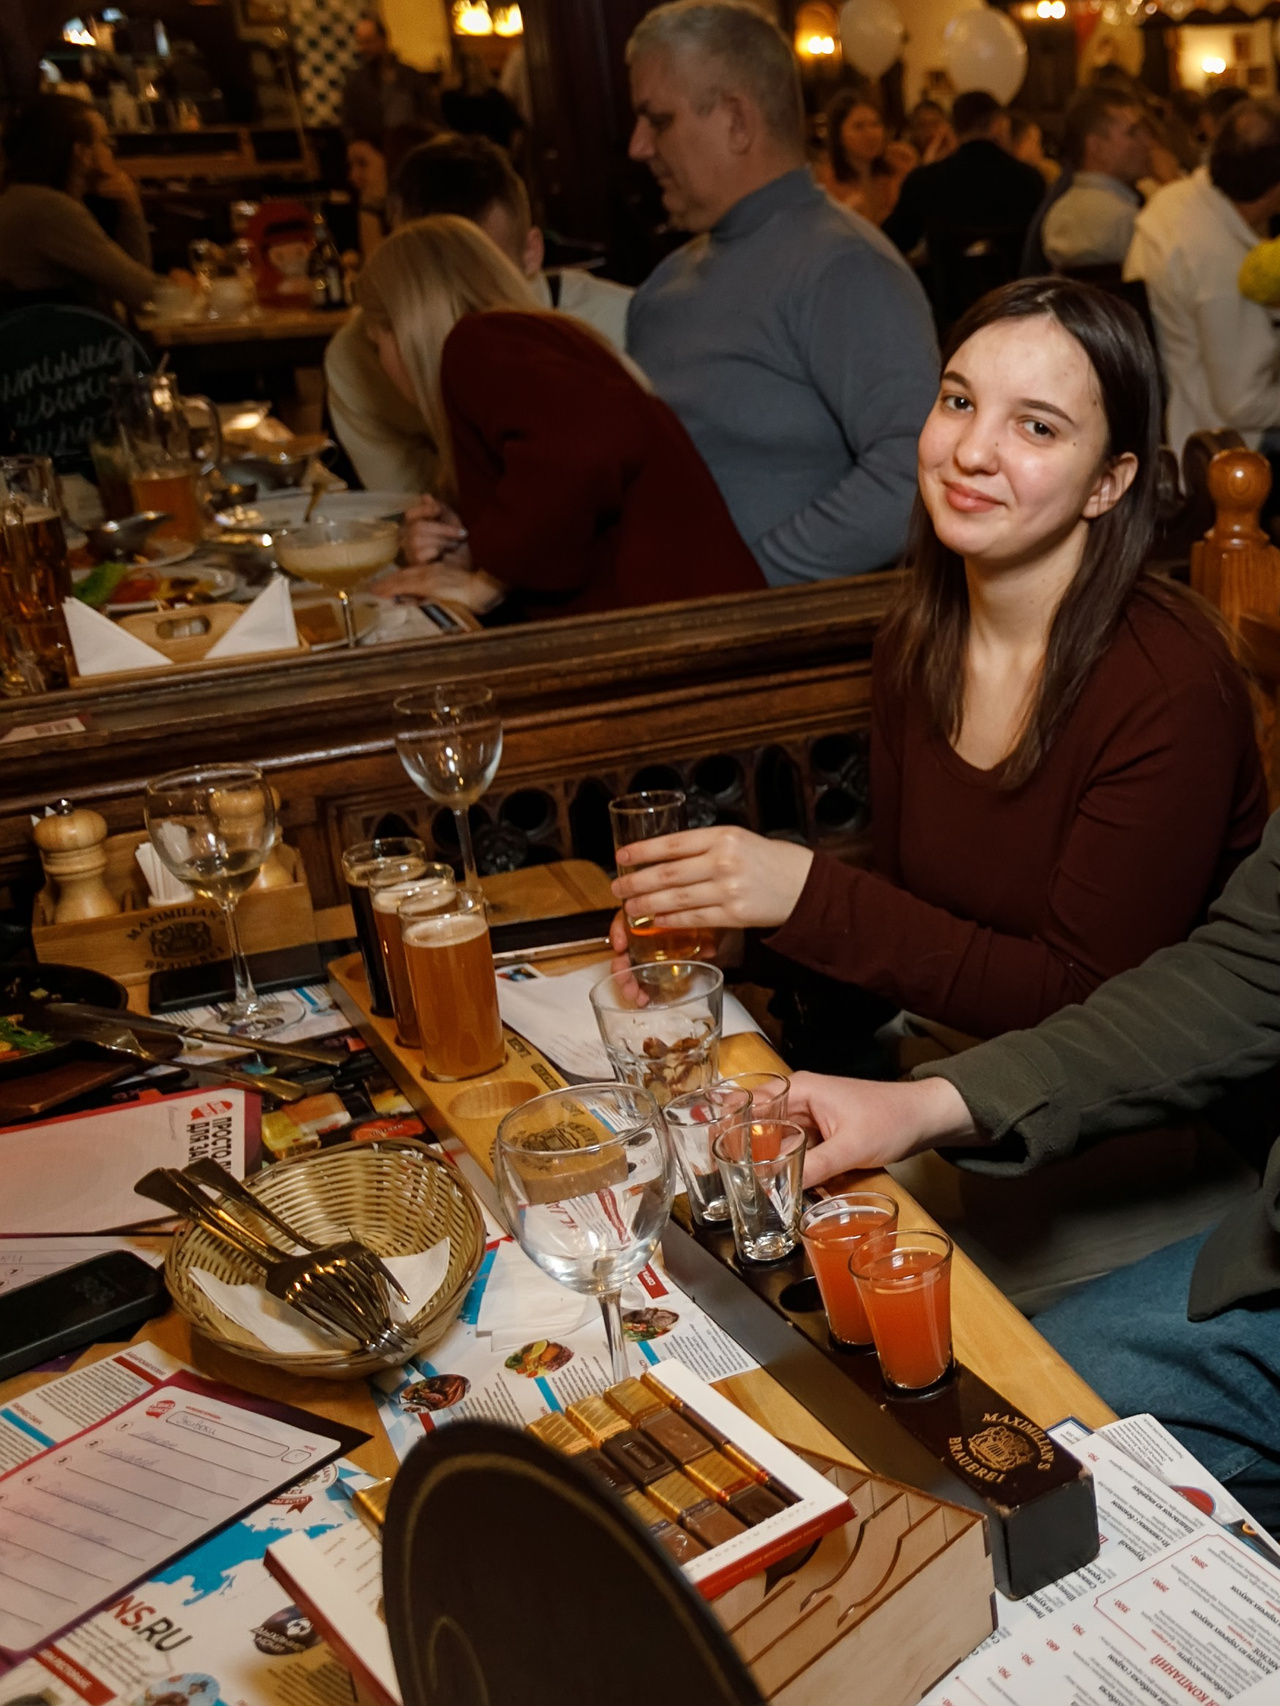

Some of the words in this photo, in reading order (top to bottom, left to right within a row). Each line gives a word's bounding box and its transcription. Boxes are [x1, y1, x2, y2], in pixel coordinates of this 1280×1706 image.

[186, 1121, 210, 1145] ДЛЯ
[211, 1116, 232, 1159] ПРОСТО
[982, 1412, 1055, 1471] MAXIMILIAN'S
[948, 1436, 1006, 1484] BRAUEREI
[1132, 1485, 1156, 1504] индейки
[1111, 1500, 1135, 1519] беконом
[1137, 1521, 1163, 1540] свинины
[1162, 1508, 1194, 1534] Шашлычок
[1118, 1540, 1146, 1561] Куриный
[1230, 1586, 1254, 1604] закусок
[1191, 1609, 1214, 1629] закусок
[1254, 1603, 1279, 1624] горячих
[1214, 1628, 1239, 1649] горячих
[1238, 1647, 1247, 1655] из
[1252, 1648, 1280, 1670] МЯСНОЕ
[1177, 1652, 1202, 1672] ассорти
[1246, 1653, 1276, 1675] Ассорти
[1150, 1654, 1209, 1703] КОМПАНИЙ
[1200, 1671, 1234, 1700] Колбасное
